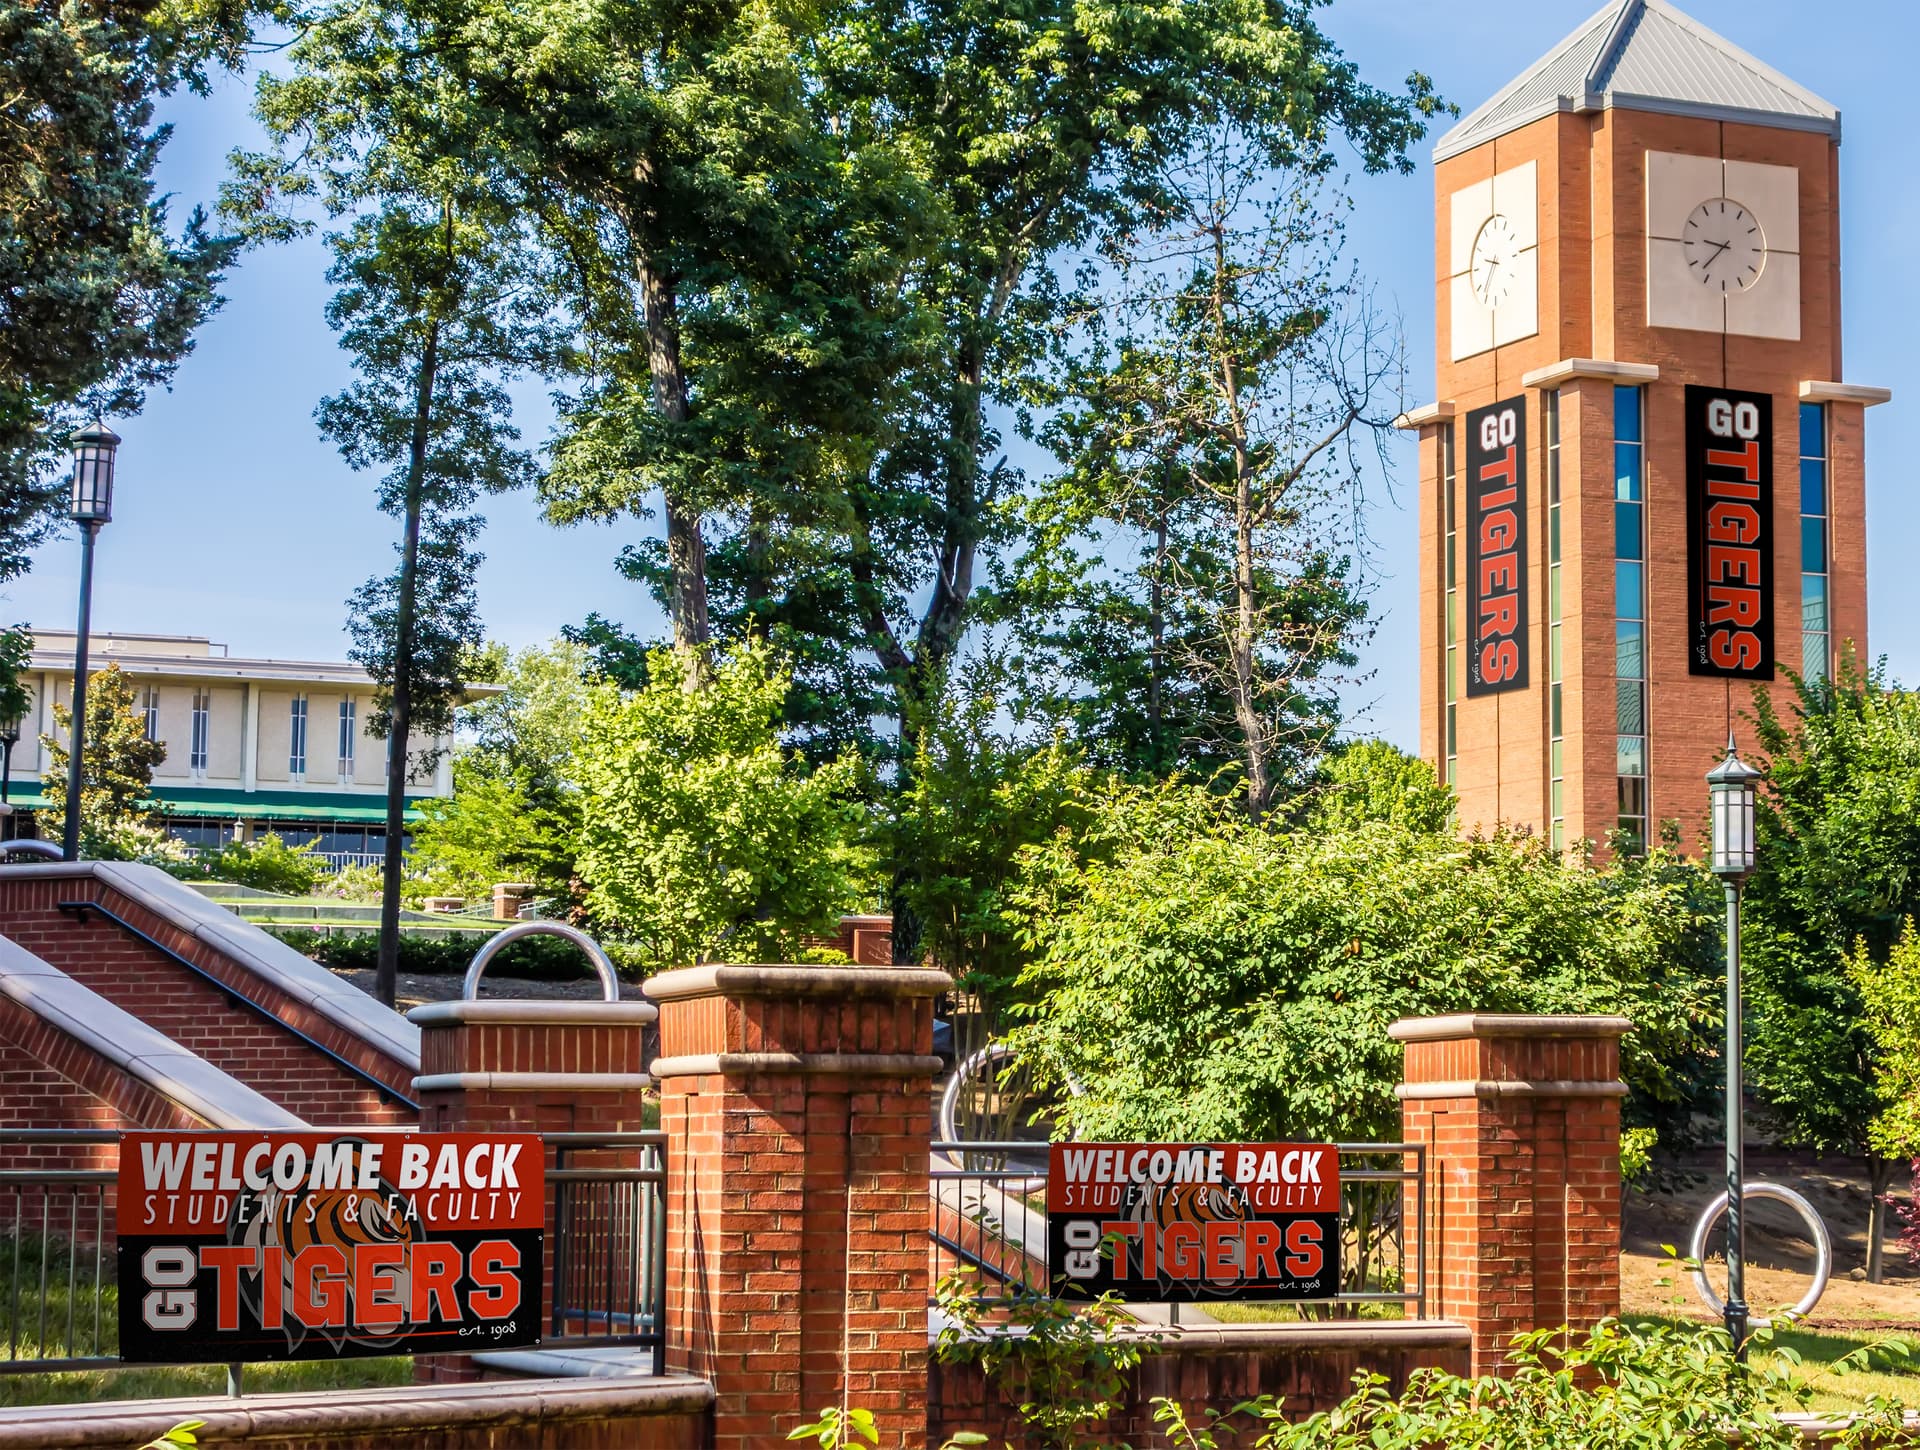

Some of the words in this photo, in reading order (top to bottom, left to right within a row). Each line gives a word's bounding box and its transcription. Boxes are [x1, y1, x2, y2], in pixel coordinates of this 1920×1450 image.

[1480, 408, 1517, 451] GO
[1707, 398, 1760, 440] GO
[1480, 443, 1519, 685] TIGERS
[1706, 440, 1762, 671] TIGERS
[140, 1142, 382, 1191] WELCOME
[399, 1143, 523, 1191] BACK
[1062, 1149, 1224, 1184] WELCOME
[1235, 1150, 1324, 1184] BACK
[143, 1194, 317, 1225] STUDENTS
[343, 1194, 360, 1222] &
[386, 1191, 522, 1222] FACULTY
[1065, 1185, 1180, 1207] STUDENTS
[1197, 1186, 1209, 1206] &
[1227, 1185, 1324, 1207] FACULTY
[1064, 1220, 1100, 1279] GO
[1101, 1220, 1324, 1281] TIGERS
[141, 1245, 198, 1331] GO
[198, 1239, 522, 1332] TIGERS
[1278, 1281, 1298, 1289] est.
[1301, 1280, 1321, 1293] 1908
[458, 1325, 486, 1337] est.
[490, 1320, 517, 1340] 1908
